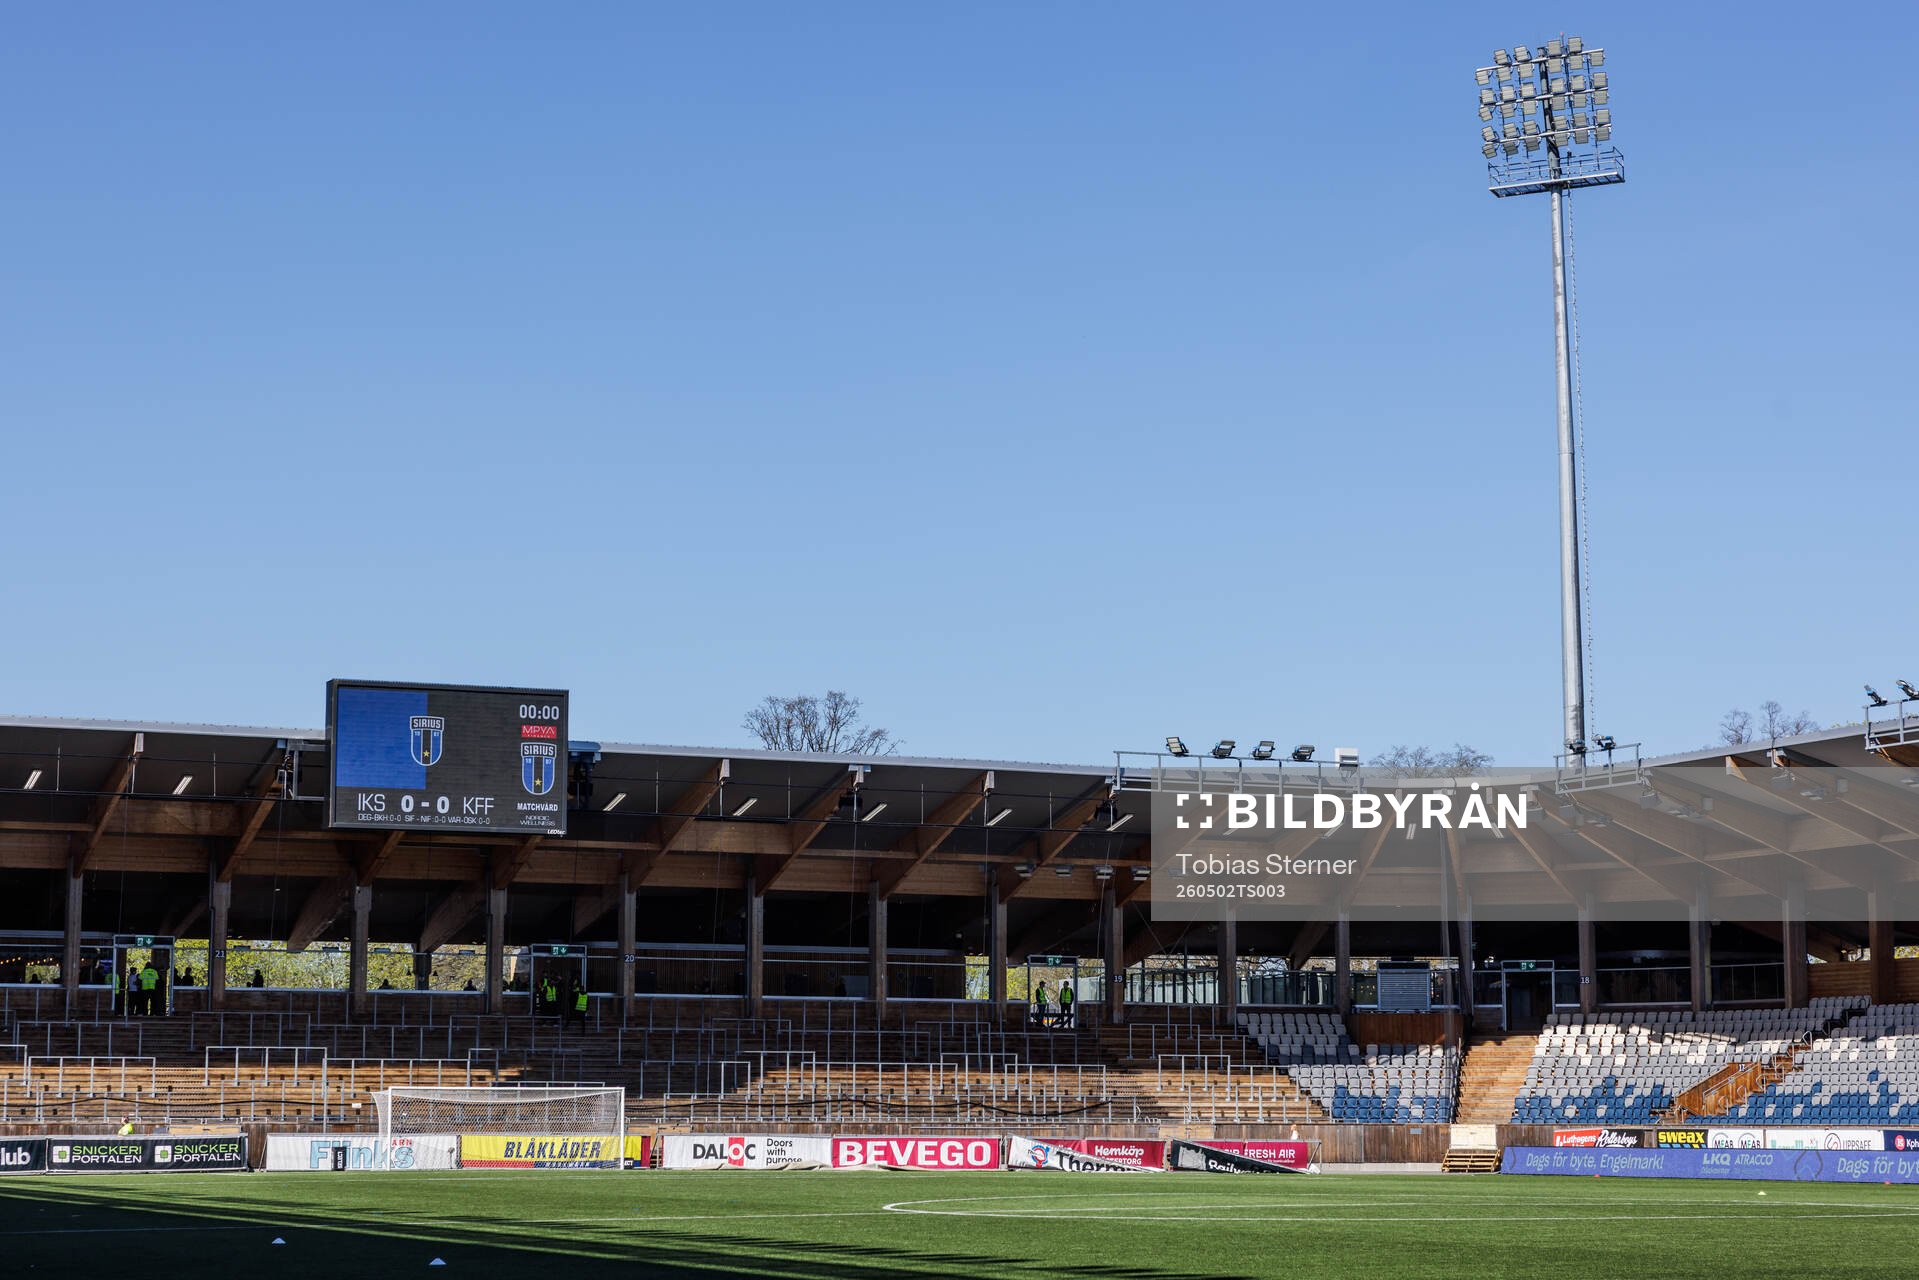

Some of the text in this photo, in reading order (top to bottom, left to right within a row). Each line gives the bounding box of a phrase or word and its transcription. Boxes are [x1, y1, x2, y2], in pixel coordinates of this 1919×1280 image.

[520, 704, 560, 720] 00:00
[413, 718, 441, 729] SIRIUS
[523, 745, 554, 756] SIRIUS
[358, 792, 386, 812] IKS
[401, 794, 414, 813] 0
[436, 796, 450, 814] 0
[463, 796, 495, 815] KFF
[215, 950, 225, 958] 21
[624, 954, 635, 963] 20
[1114, 975, 1123, 983] 19
[1580, 976, 1590, 984] 18
[766, 1138, 793, 1147] Doors
[1658, 1131, 1705, 1143] sweax
[72, 1145, 142, 1155] SNICKERI
[503, 1137, 601, 1159] BLÅKLÄDER
[693, 1143, 756, 1161] DALOC
[766, 1147, 786, 1156] with
[839, 1140, 991, 1166] BEVEGO
[1094, 1145, 1144, 1158] Hemköp
[71, 1155, 142, 1164] PORTALEN
[173, 1153, 241, 1163] PORTALEN
[1243, 1149, 1296, 1159] FRESH AIR
[1702, 1153, 1774, 1166] LKQ ATRACCO
[1526, 1151, 1664, 1173] Dags för byte, Engelmark!
[1837, 1157, 1870, 1178] Dags
[1873, 1156, 1895, 1174] för
